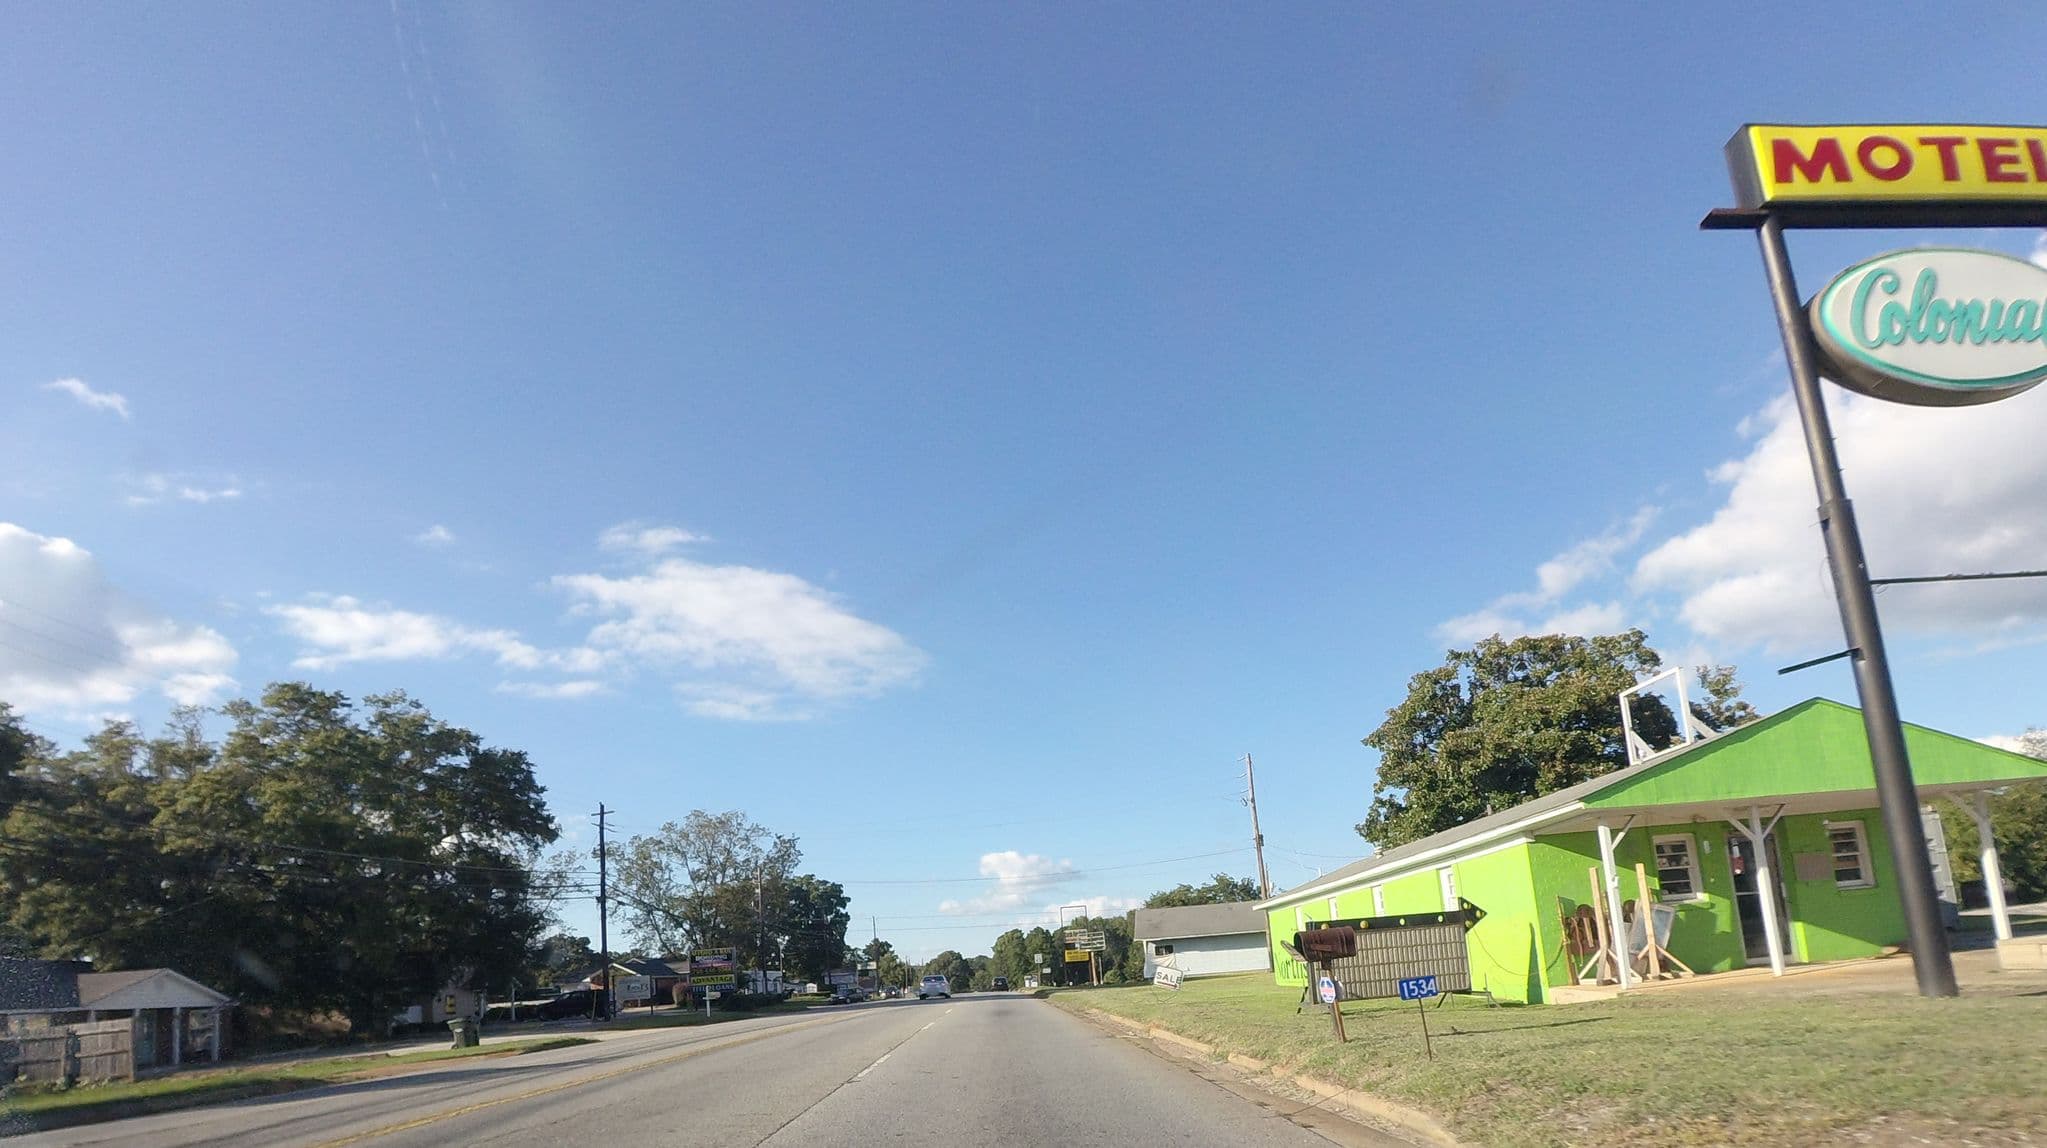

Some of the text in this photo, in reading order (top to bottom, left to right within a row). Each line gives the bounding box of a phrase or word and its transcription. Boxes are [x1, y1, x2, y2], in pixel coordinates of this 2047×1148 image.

[1851, 266, 2047, 349] Colonia
[692, 975, 734, 985] ADVANTAGE
[1157, 971, 1182, 985] SALE
[1402, 978, 1436, 999] 1534
